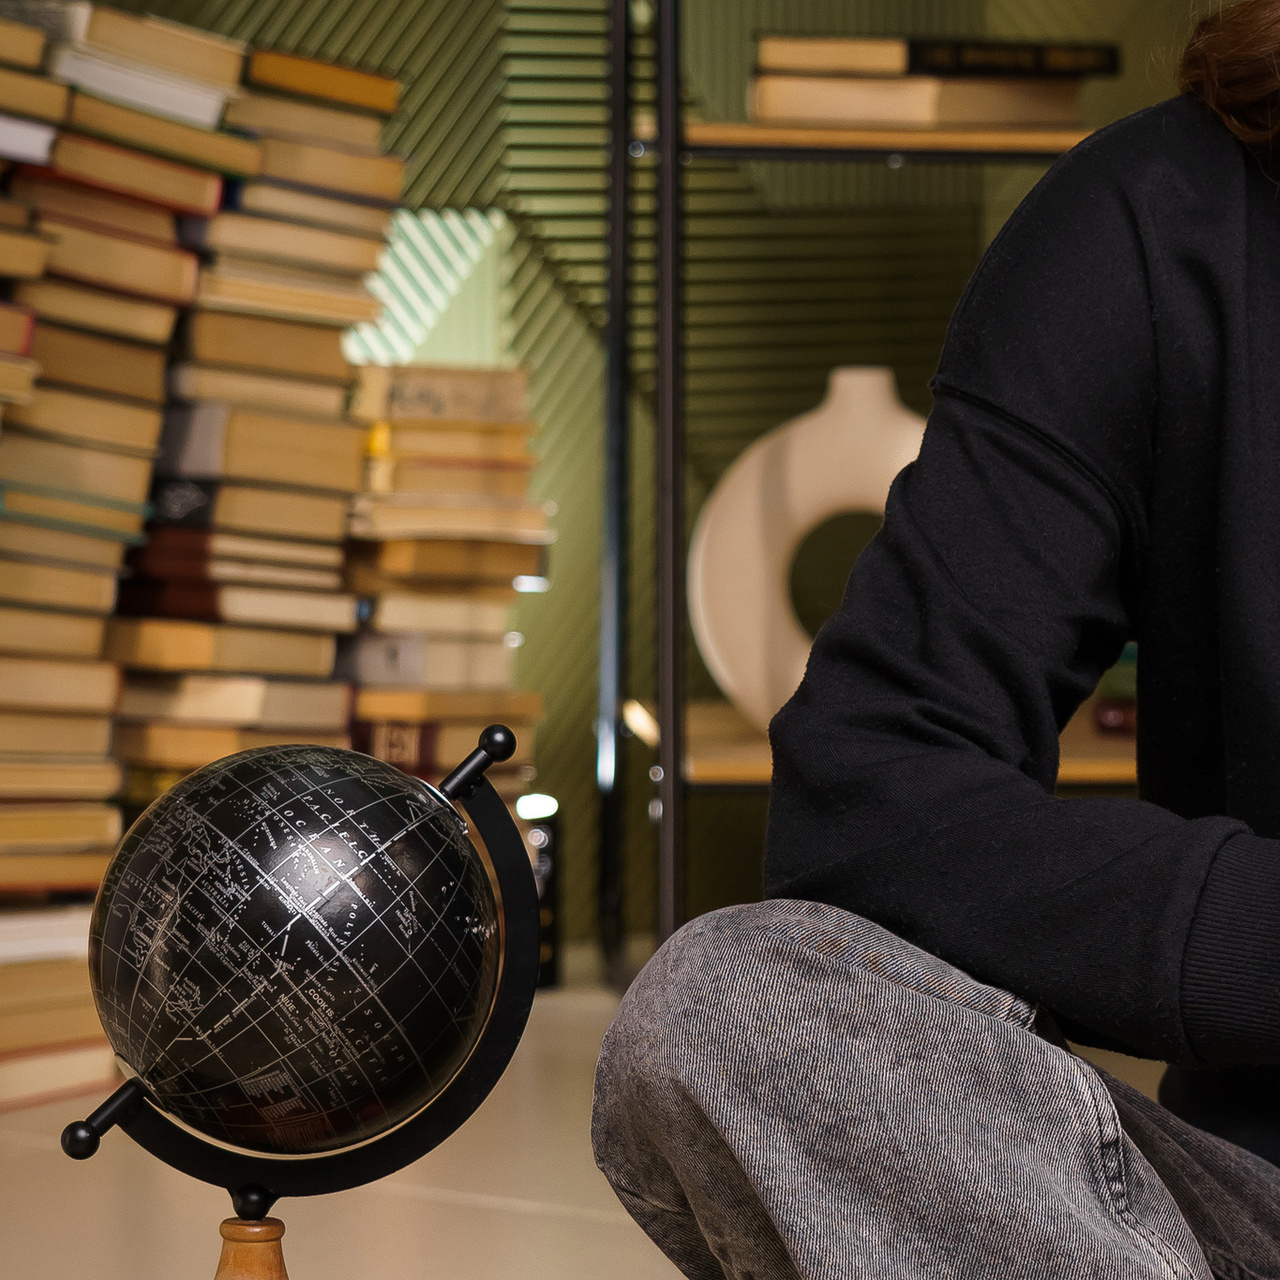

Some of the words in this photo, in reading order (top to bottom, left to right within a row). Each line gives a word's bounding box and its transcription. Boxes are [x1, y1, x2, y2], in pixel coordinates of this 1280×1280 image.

[284, 810, 346, 868] OCEAN
[276, 992, 296, 1013] NIUE
[306, 987, 328, 1011] COOK
[324, 1006, 336, 1019] IS.
